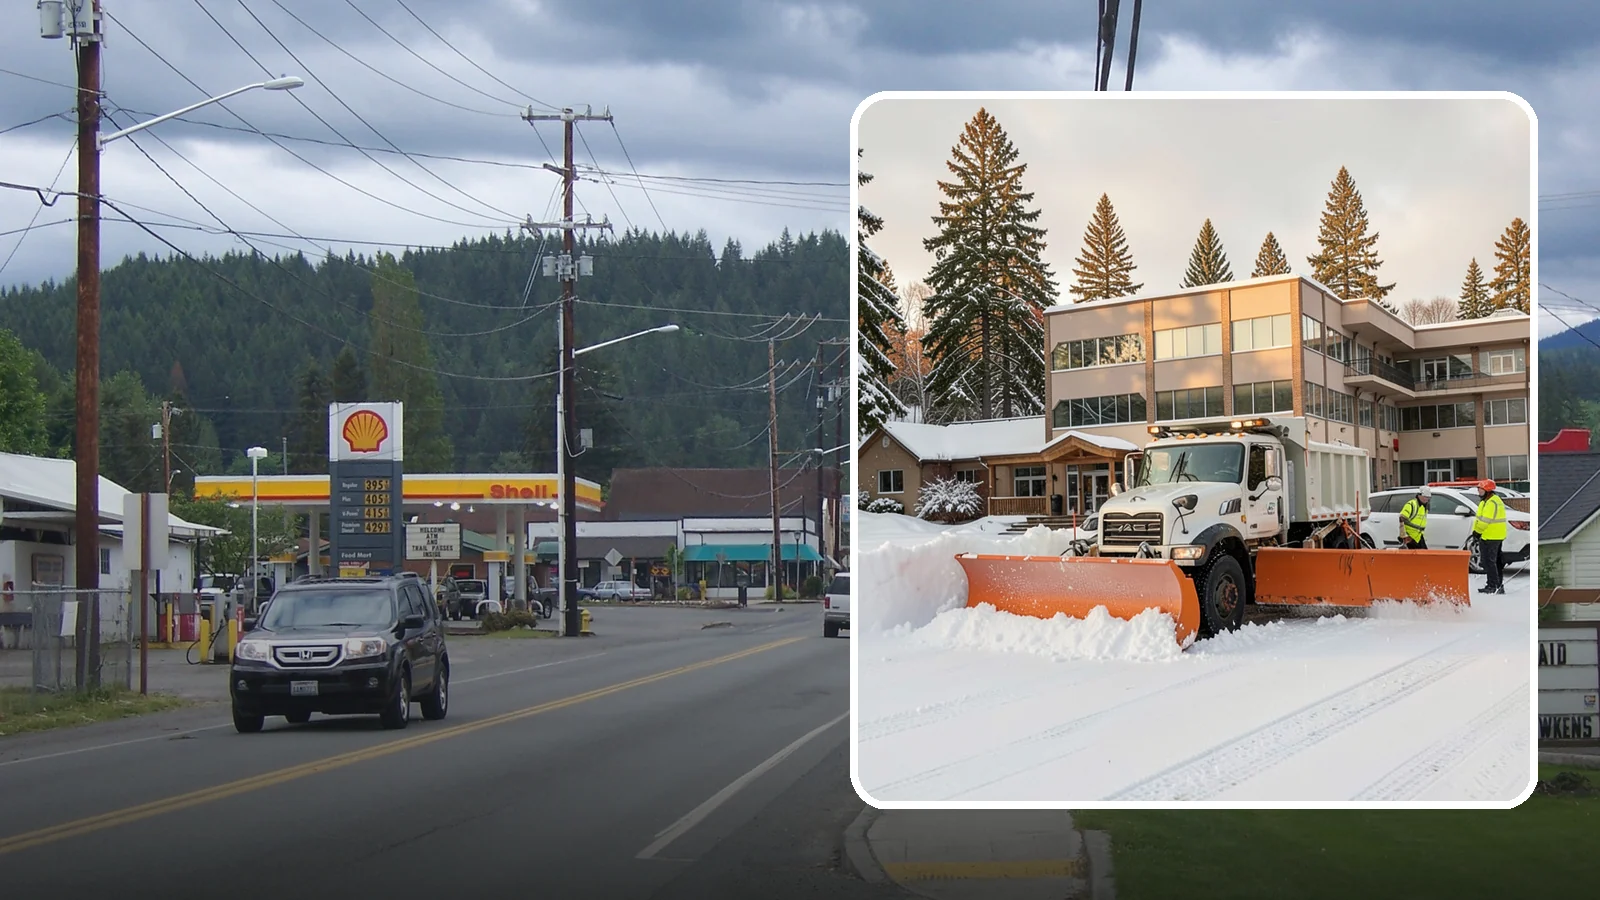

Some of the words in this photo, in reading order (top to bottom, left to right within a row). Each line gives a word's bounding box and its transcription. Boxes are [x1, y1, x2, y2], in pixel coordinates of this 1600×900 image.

[366, 480, 384, 490] 395
[490, 484, 547, 499] Shell
[366, 494, 384, 504] 405
[366, 522, 383, 532] 429
[1538, 642, 1567, 665] AID
